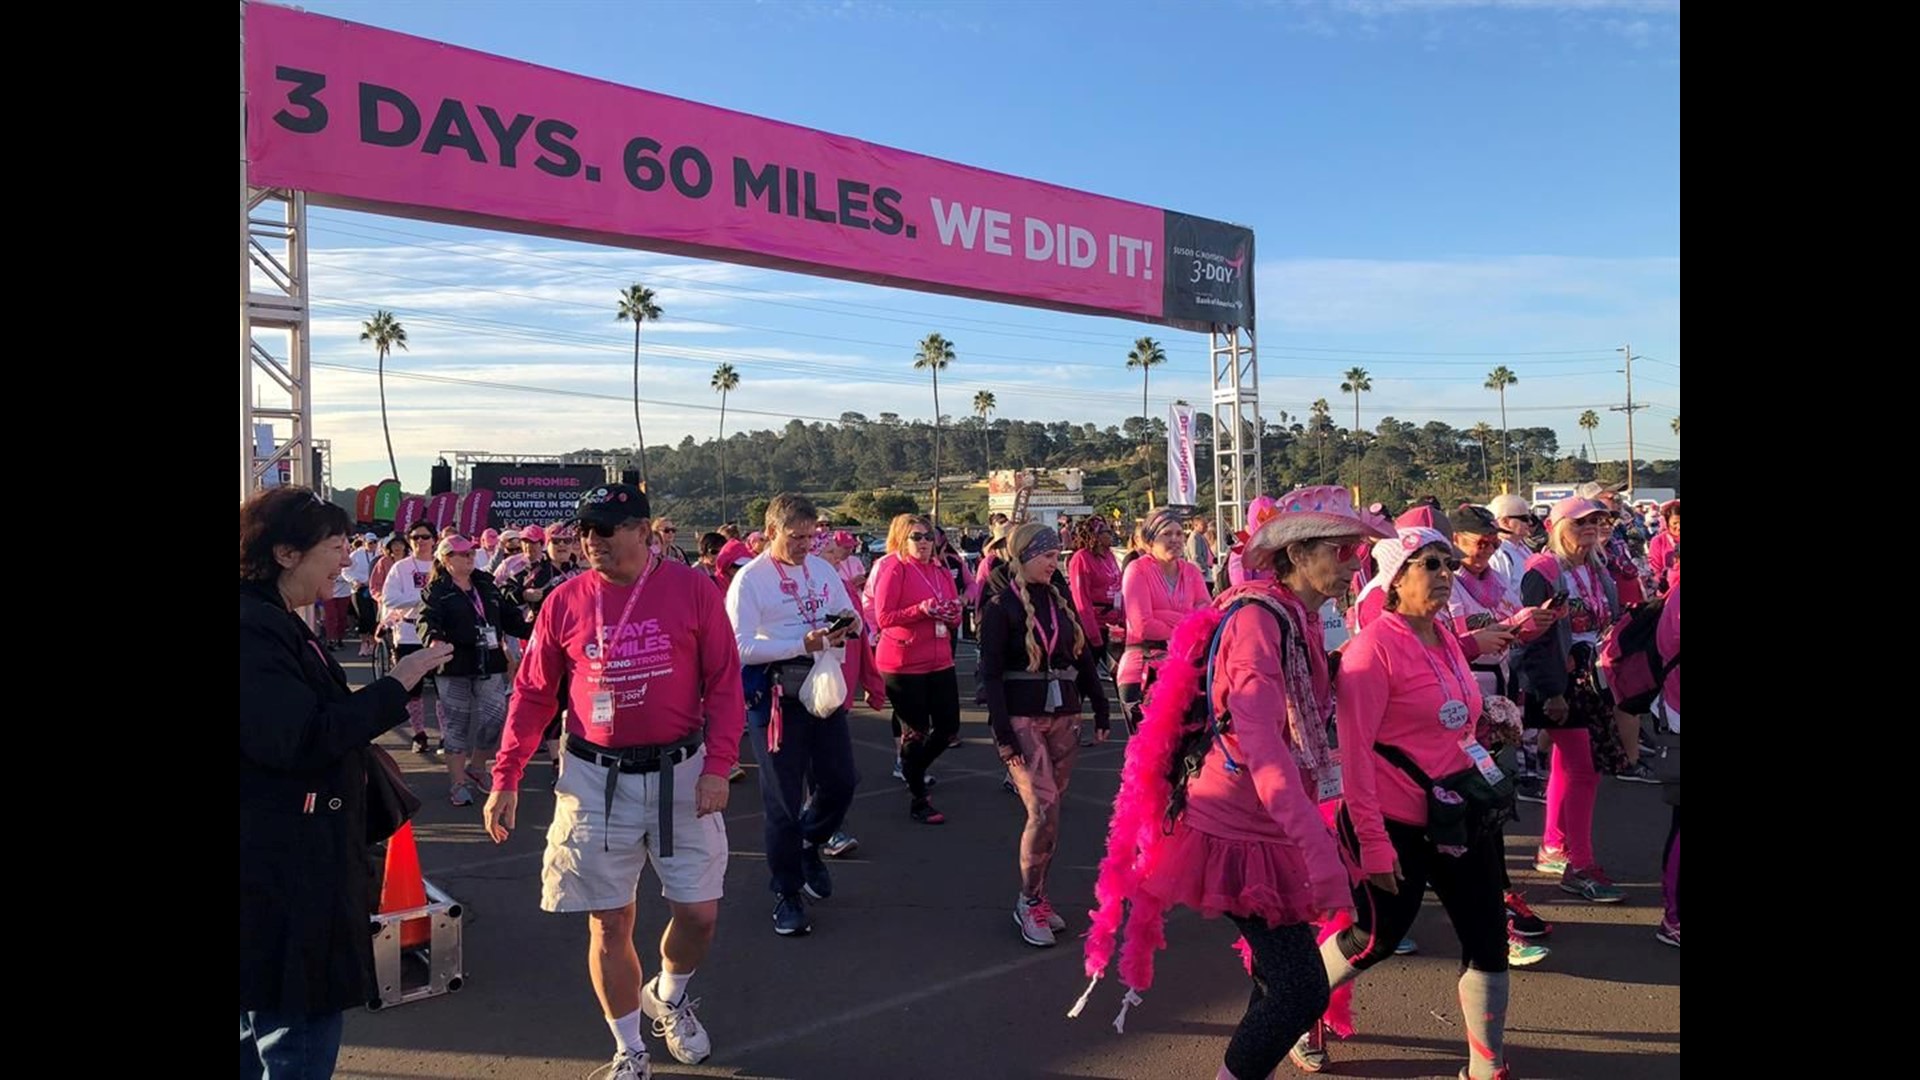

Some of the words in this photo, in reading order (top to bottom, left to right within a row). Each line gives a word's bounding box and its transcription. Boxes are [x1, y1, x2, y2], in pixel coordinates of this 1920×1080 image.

[272, 65, 329, 134] 3
[358, 82, 601, 183] DAYS.
[623, 137, 713, 199] 60
[732, 156, 917, 239] MILES.
[930, 197, 1012, 256] WE
[1024, 218, 1097, 269] DID
[1109, 234, 1153, 280] IT!
[500, 477, 523, 486] OUR
[527, 477, 580, 487] PROMISE:
[496, 491, 544, 500] TOGETHER
[547, 491, 556, 500] IN
[490, 501, 511, 509] AND
[512, 501, 547, 509] UNITED
[549, 501, 558, 509] IN
[495, 509, 511, 517] WE
[514, 509, 530, 517] LAY
[533, 509, 562, 517] DOWN
